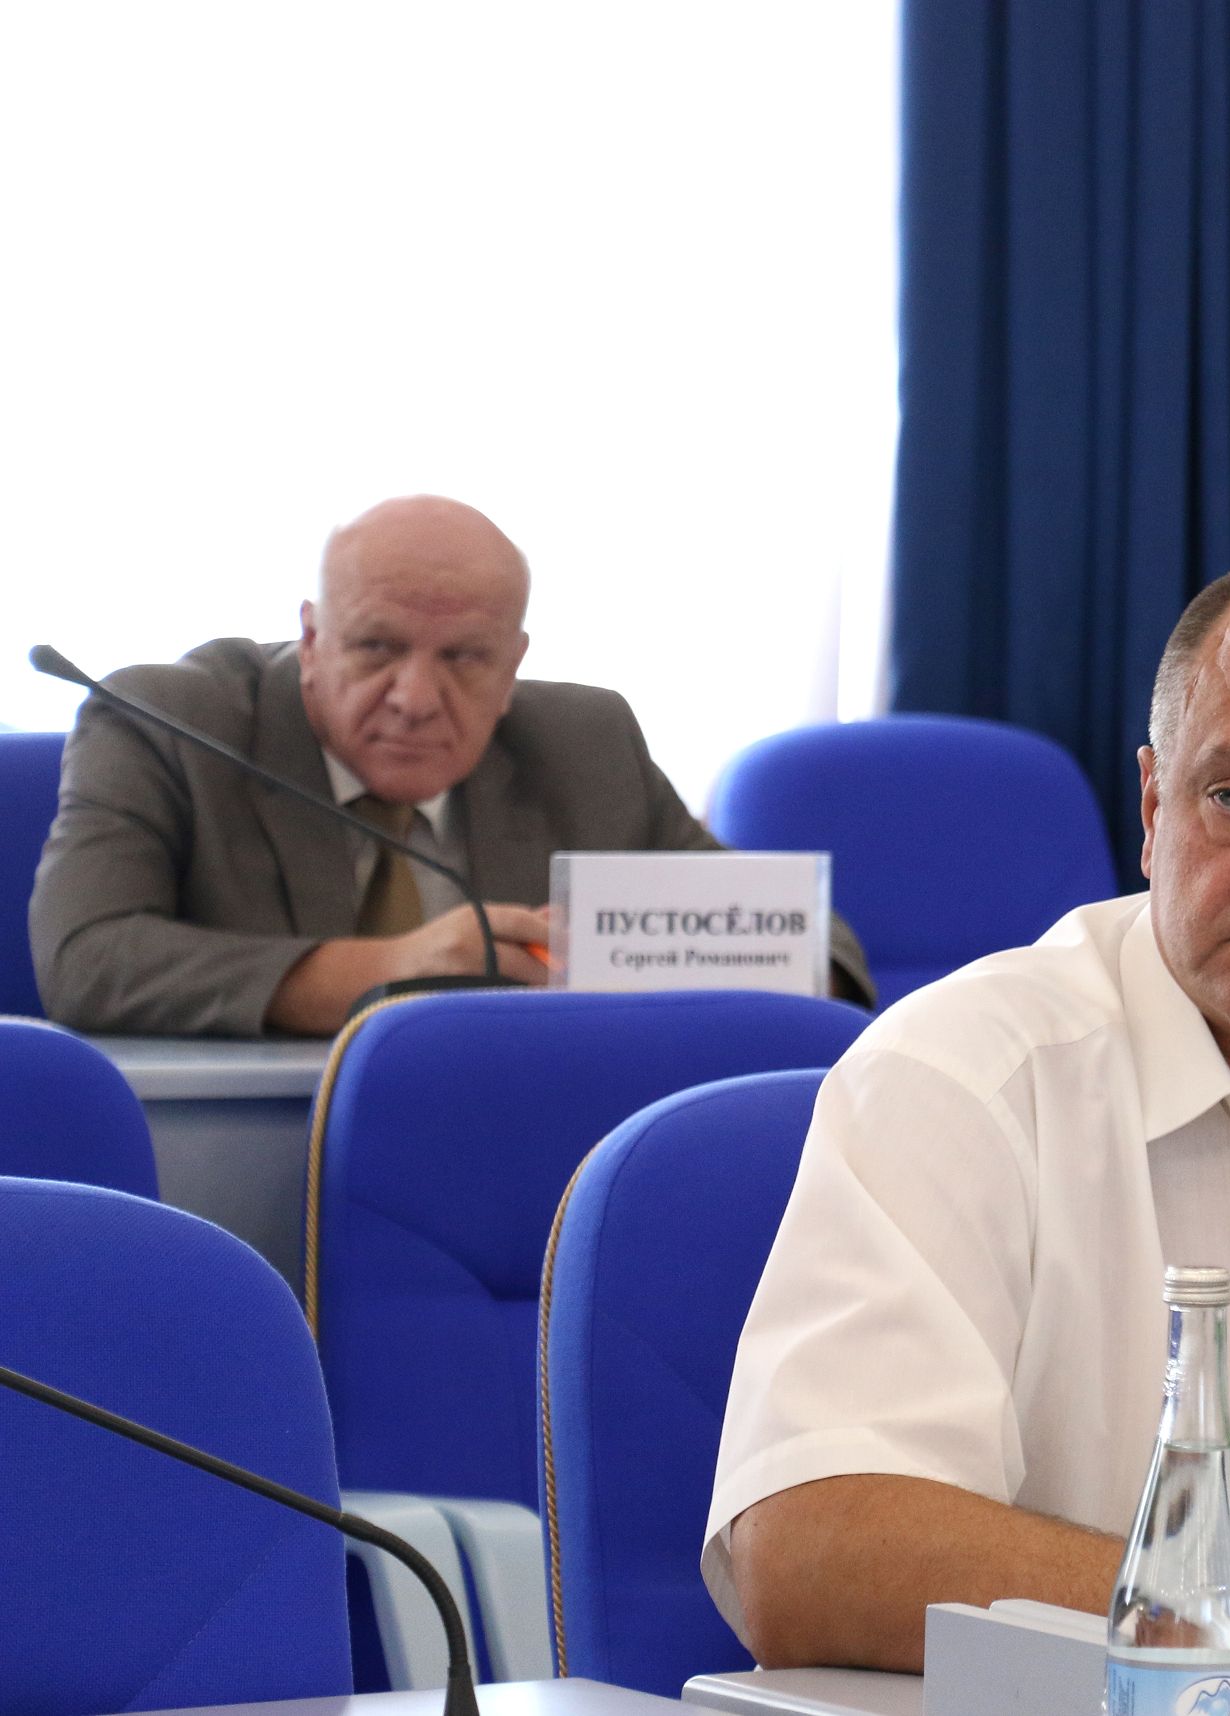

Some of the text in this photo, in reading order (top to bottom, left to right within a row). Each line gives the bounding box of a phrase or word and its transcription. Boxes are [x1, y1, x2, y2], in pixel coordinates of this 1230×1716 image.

[595, 903, 807, 936] ПУСТОСЁЛОВ
[610, 949, 790, 972] Сергей Романович
